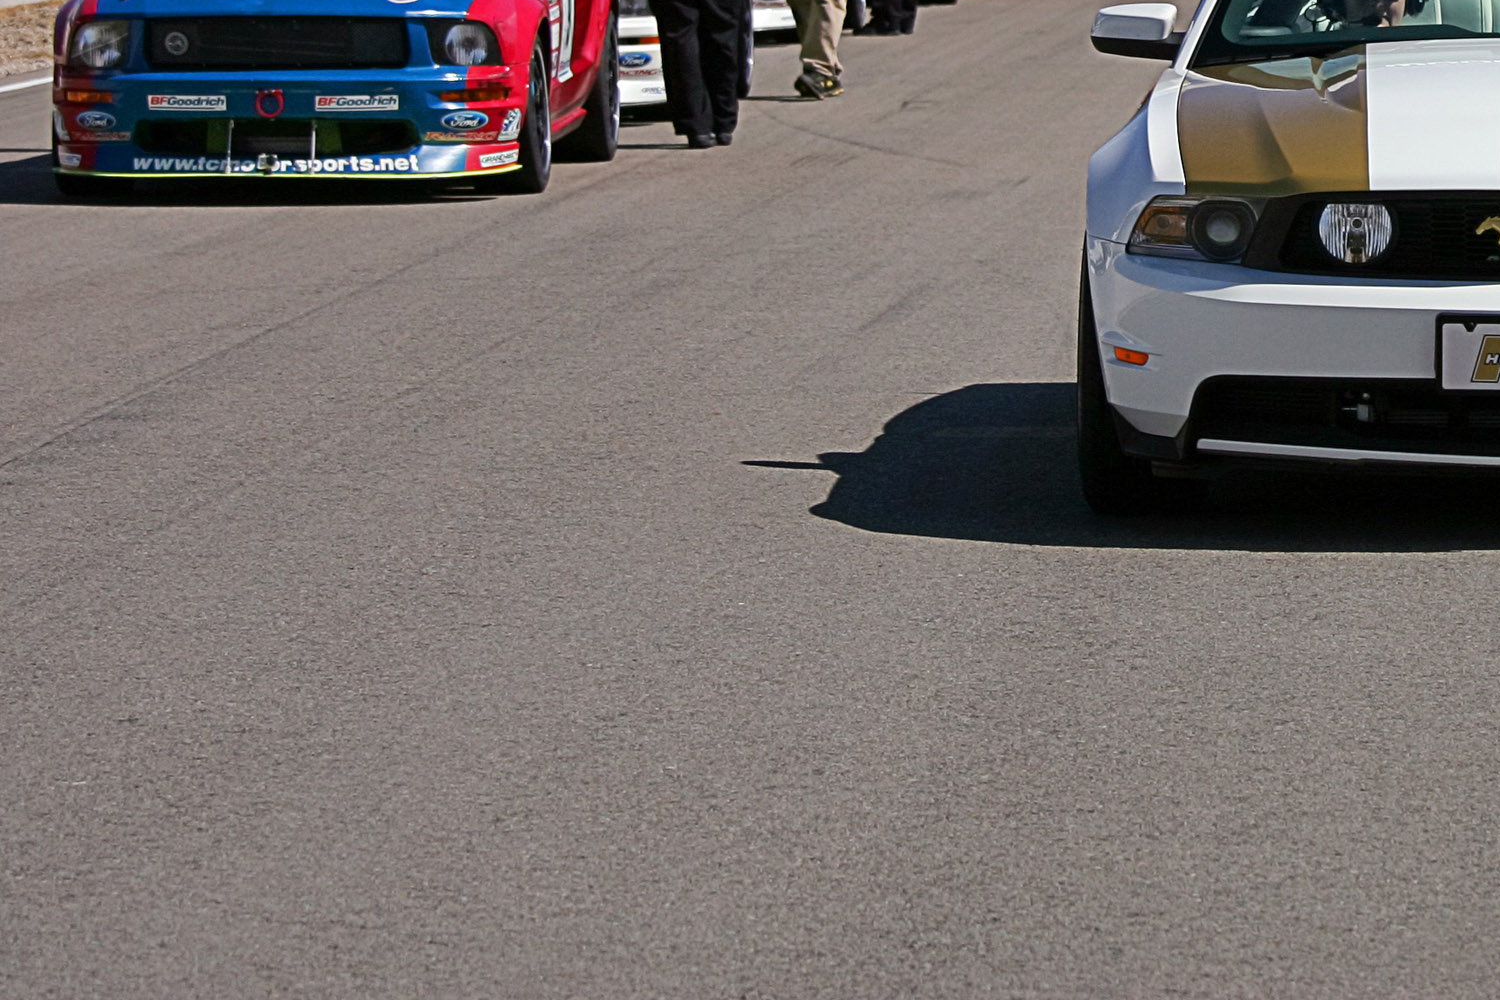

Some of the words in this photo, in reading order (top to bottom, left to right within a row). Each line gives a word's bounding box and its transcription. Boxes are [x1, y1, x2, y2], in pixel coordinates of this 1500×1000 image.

[150, 96, 224, 106] BFGoodrich
[317, 96, 397, 106] BFGoodrich
[450, 114, 479, 127] Ford
